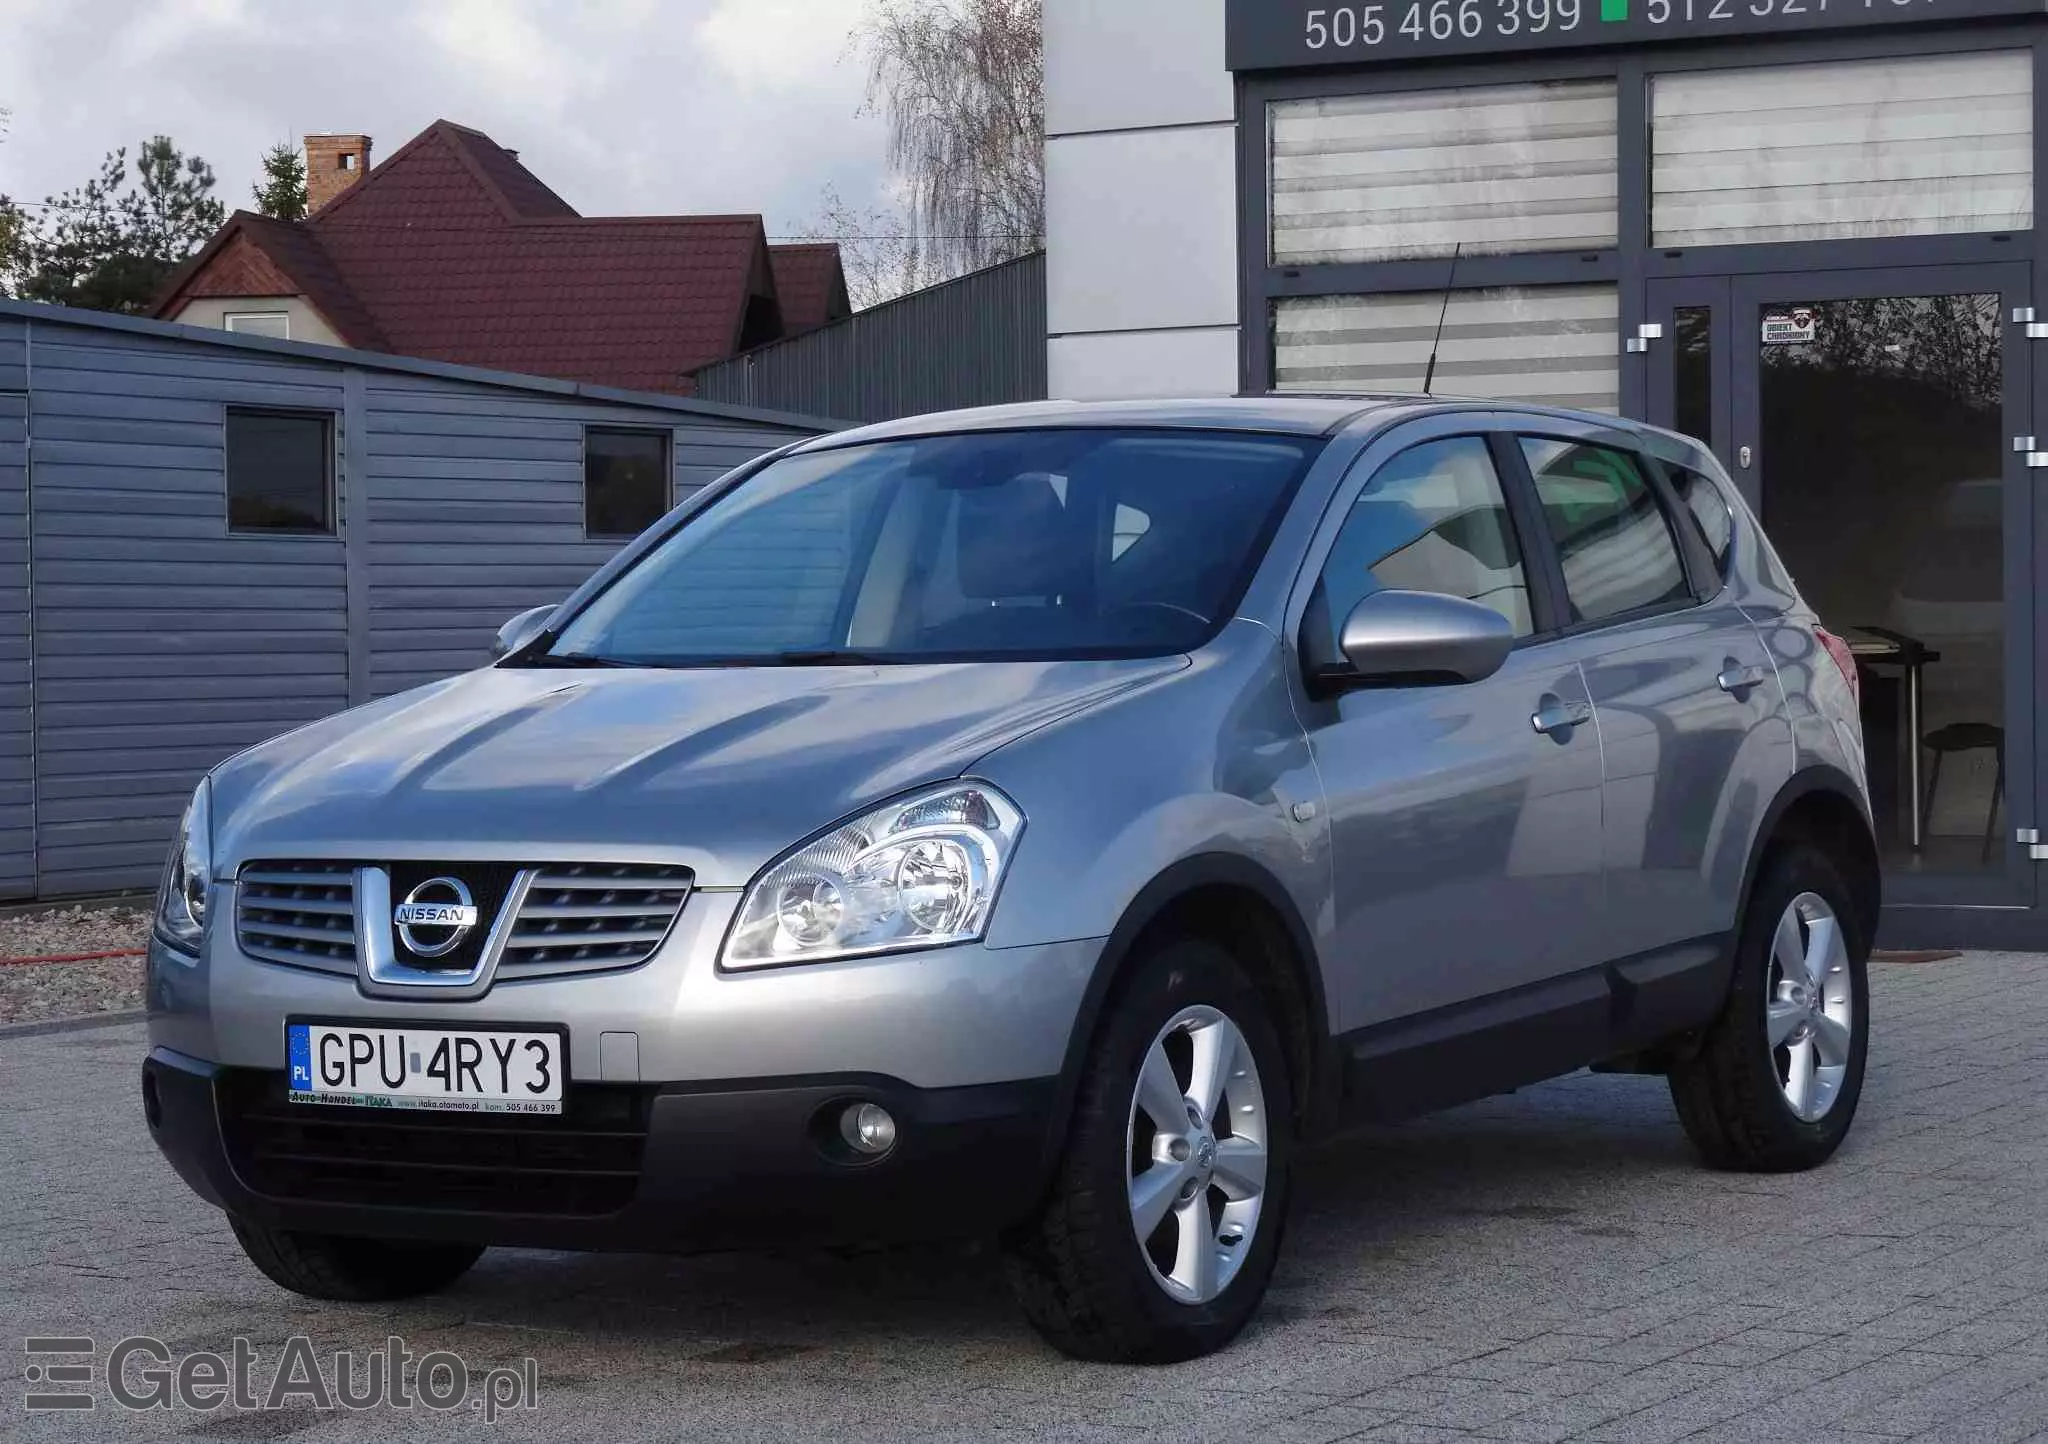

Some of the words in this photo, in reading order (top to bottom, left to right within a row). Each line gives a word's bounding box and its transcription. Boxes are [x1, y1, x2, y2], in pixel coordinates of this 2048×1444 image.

[1305, 6, 1385, 49] 505
[1399, 0, 1482, 41] 466
[1497, 0, 1581, 35] 399
[400, 908, 464, 921] NISSAN
[319, 1033, 406, 1089] GPU
[426, 1037, 551, 1094] 4RY3
[294, 1065, 310, 1081] PL
[505, 1103, 521, 1111] 505
[523, 1104, 538, 1112] 466
[541, 1104, 556, 1112] 399
